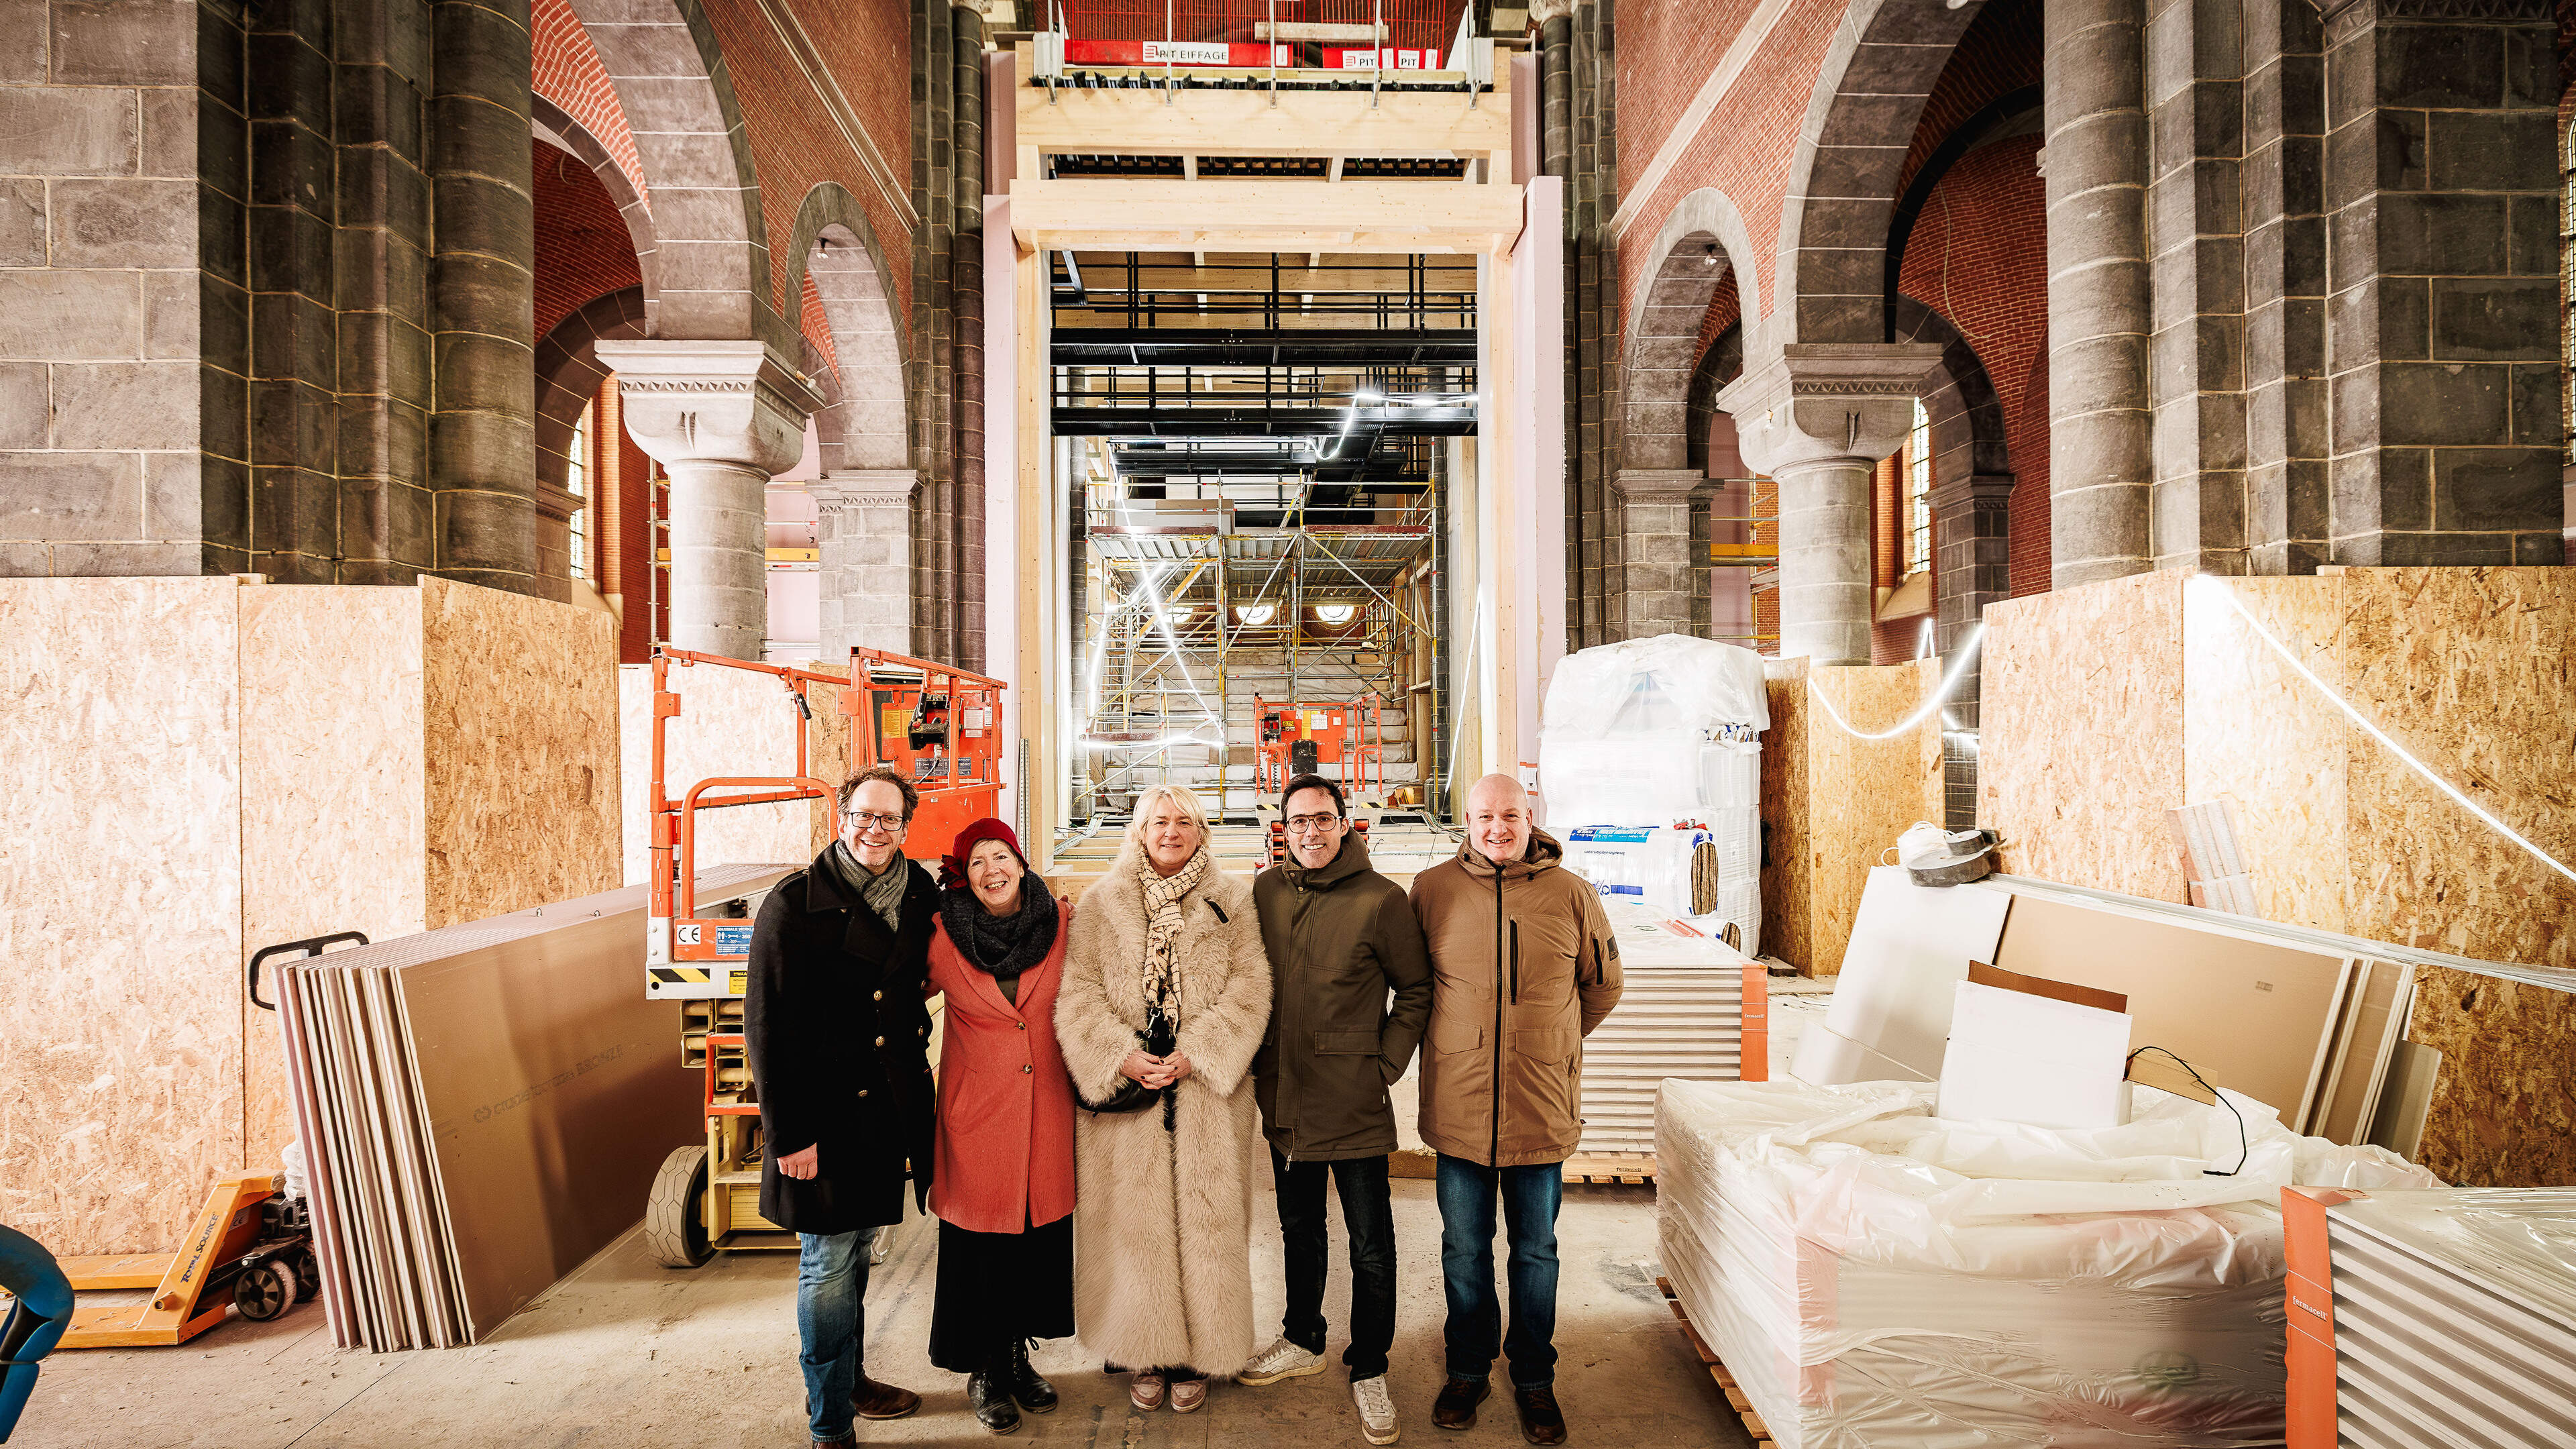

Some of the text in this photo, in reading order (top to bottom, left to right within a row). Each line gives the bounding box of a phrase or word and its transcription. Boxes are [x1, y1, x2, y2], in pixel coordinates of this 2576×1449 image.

[1180, 50, 1227, 60] EIFFAGE
[1401, 58, 1416, 66] PIT
[679, 927, 699, 942] CE
[196, 1213, 219, 1253] SOURCE
[2292, 1295, 2326, 1321] fermacell
